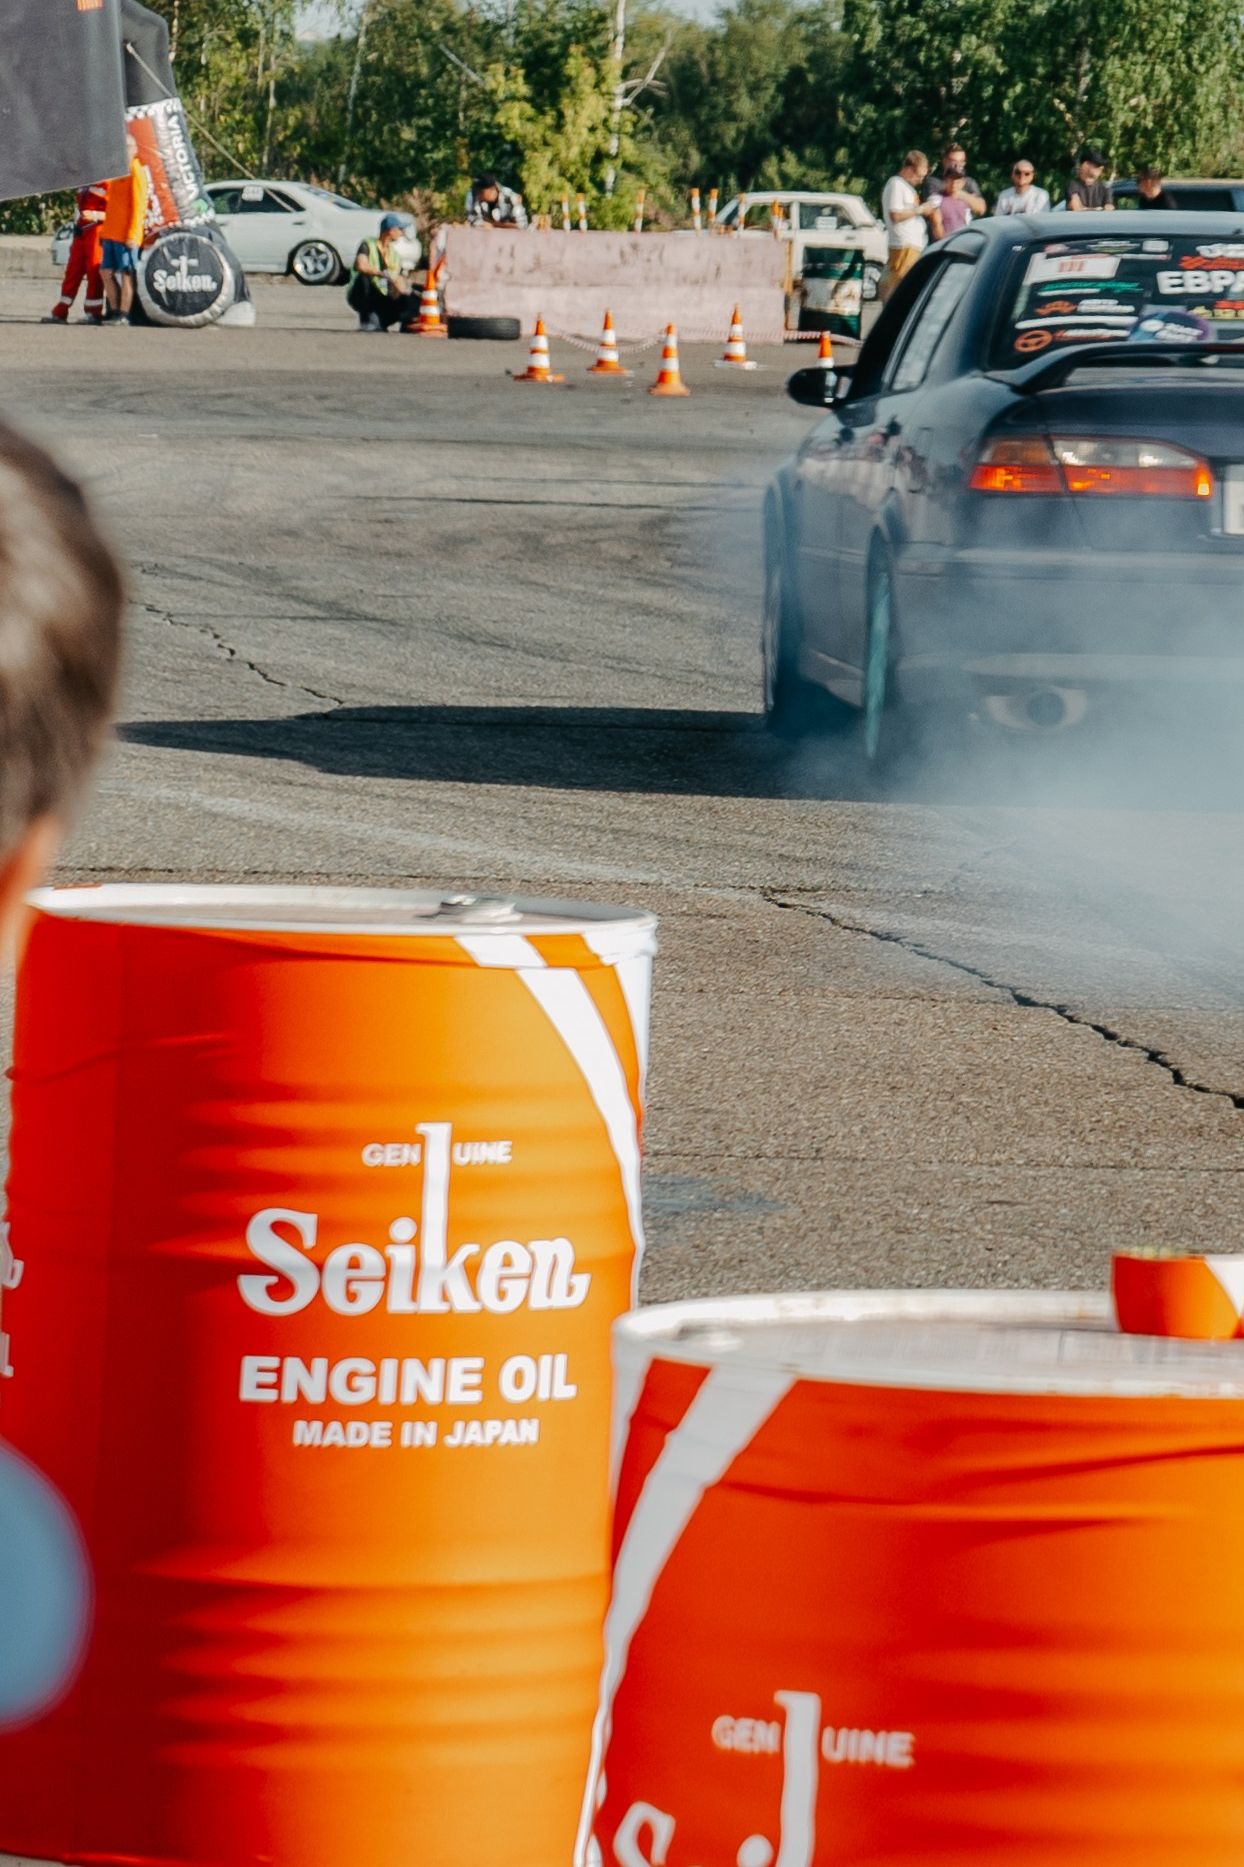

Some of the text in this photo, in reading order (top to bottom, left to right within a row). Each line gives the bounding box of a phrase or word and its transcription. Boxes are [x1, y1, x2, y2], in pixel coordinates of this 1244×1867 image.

[237, 1121, 593, 1317] Seiken
[239, 1352, 578, 1406] ENGINE OIL
[292, 1417, 541, 1449] MADE IN JAPAN
